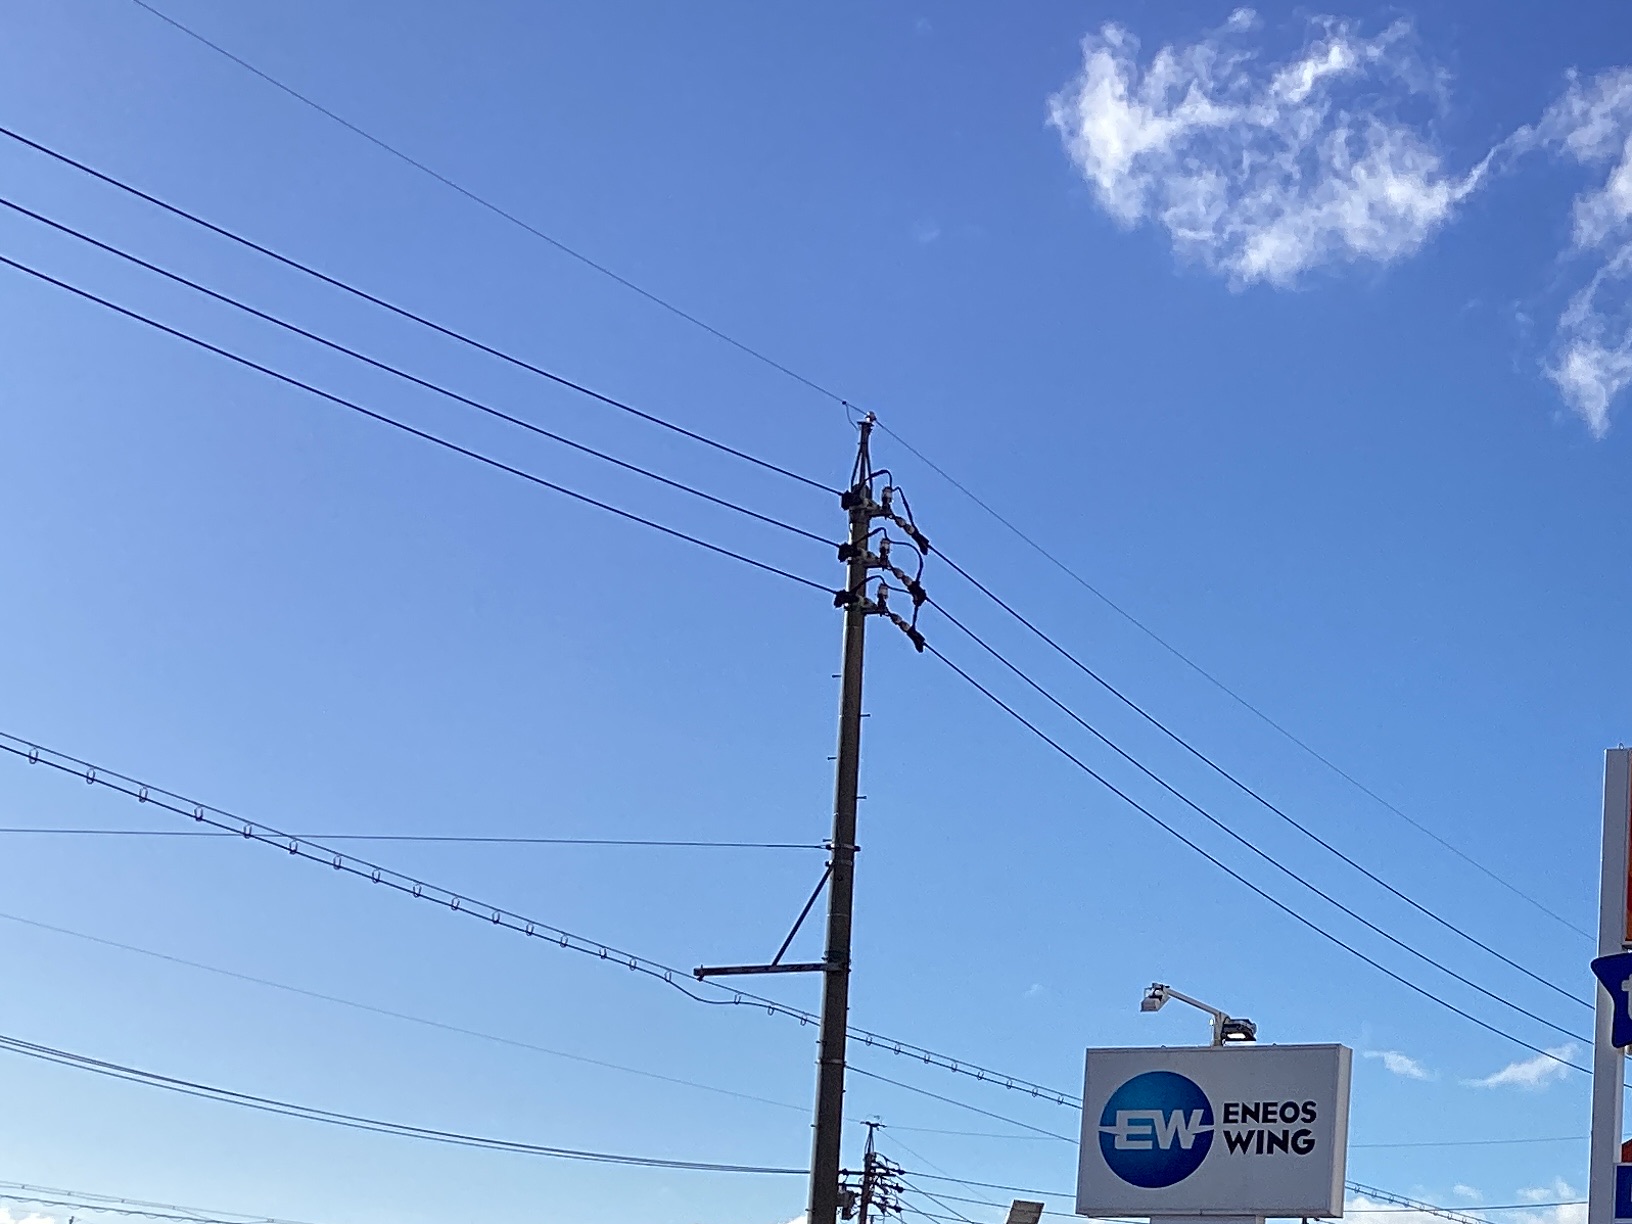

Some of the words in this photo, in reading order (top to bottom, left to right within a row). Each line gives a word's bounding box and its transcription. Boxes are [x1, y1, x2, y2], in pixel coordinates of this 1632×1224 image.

[1222, 1100, 1317, 1125] ENEOS
[1114, 1108, 1205, 1150] EW
[1222, 1128, 1316, 1156] WING
